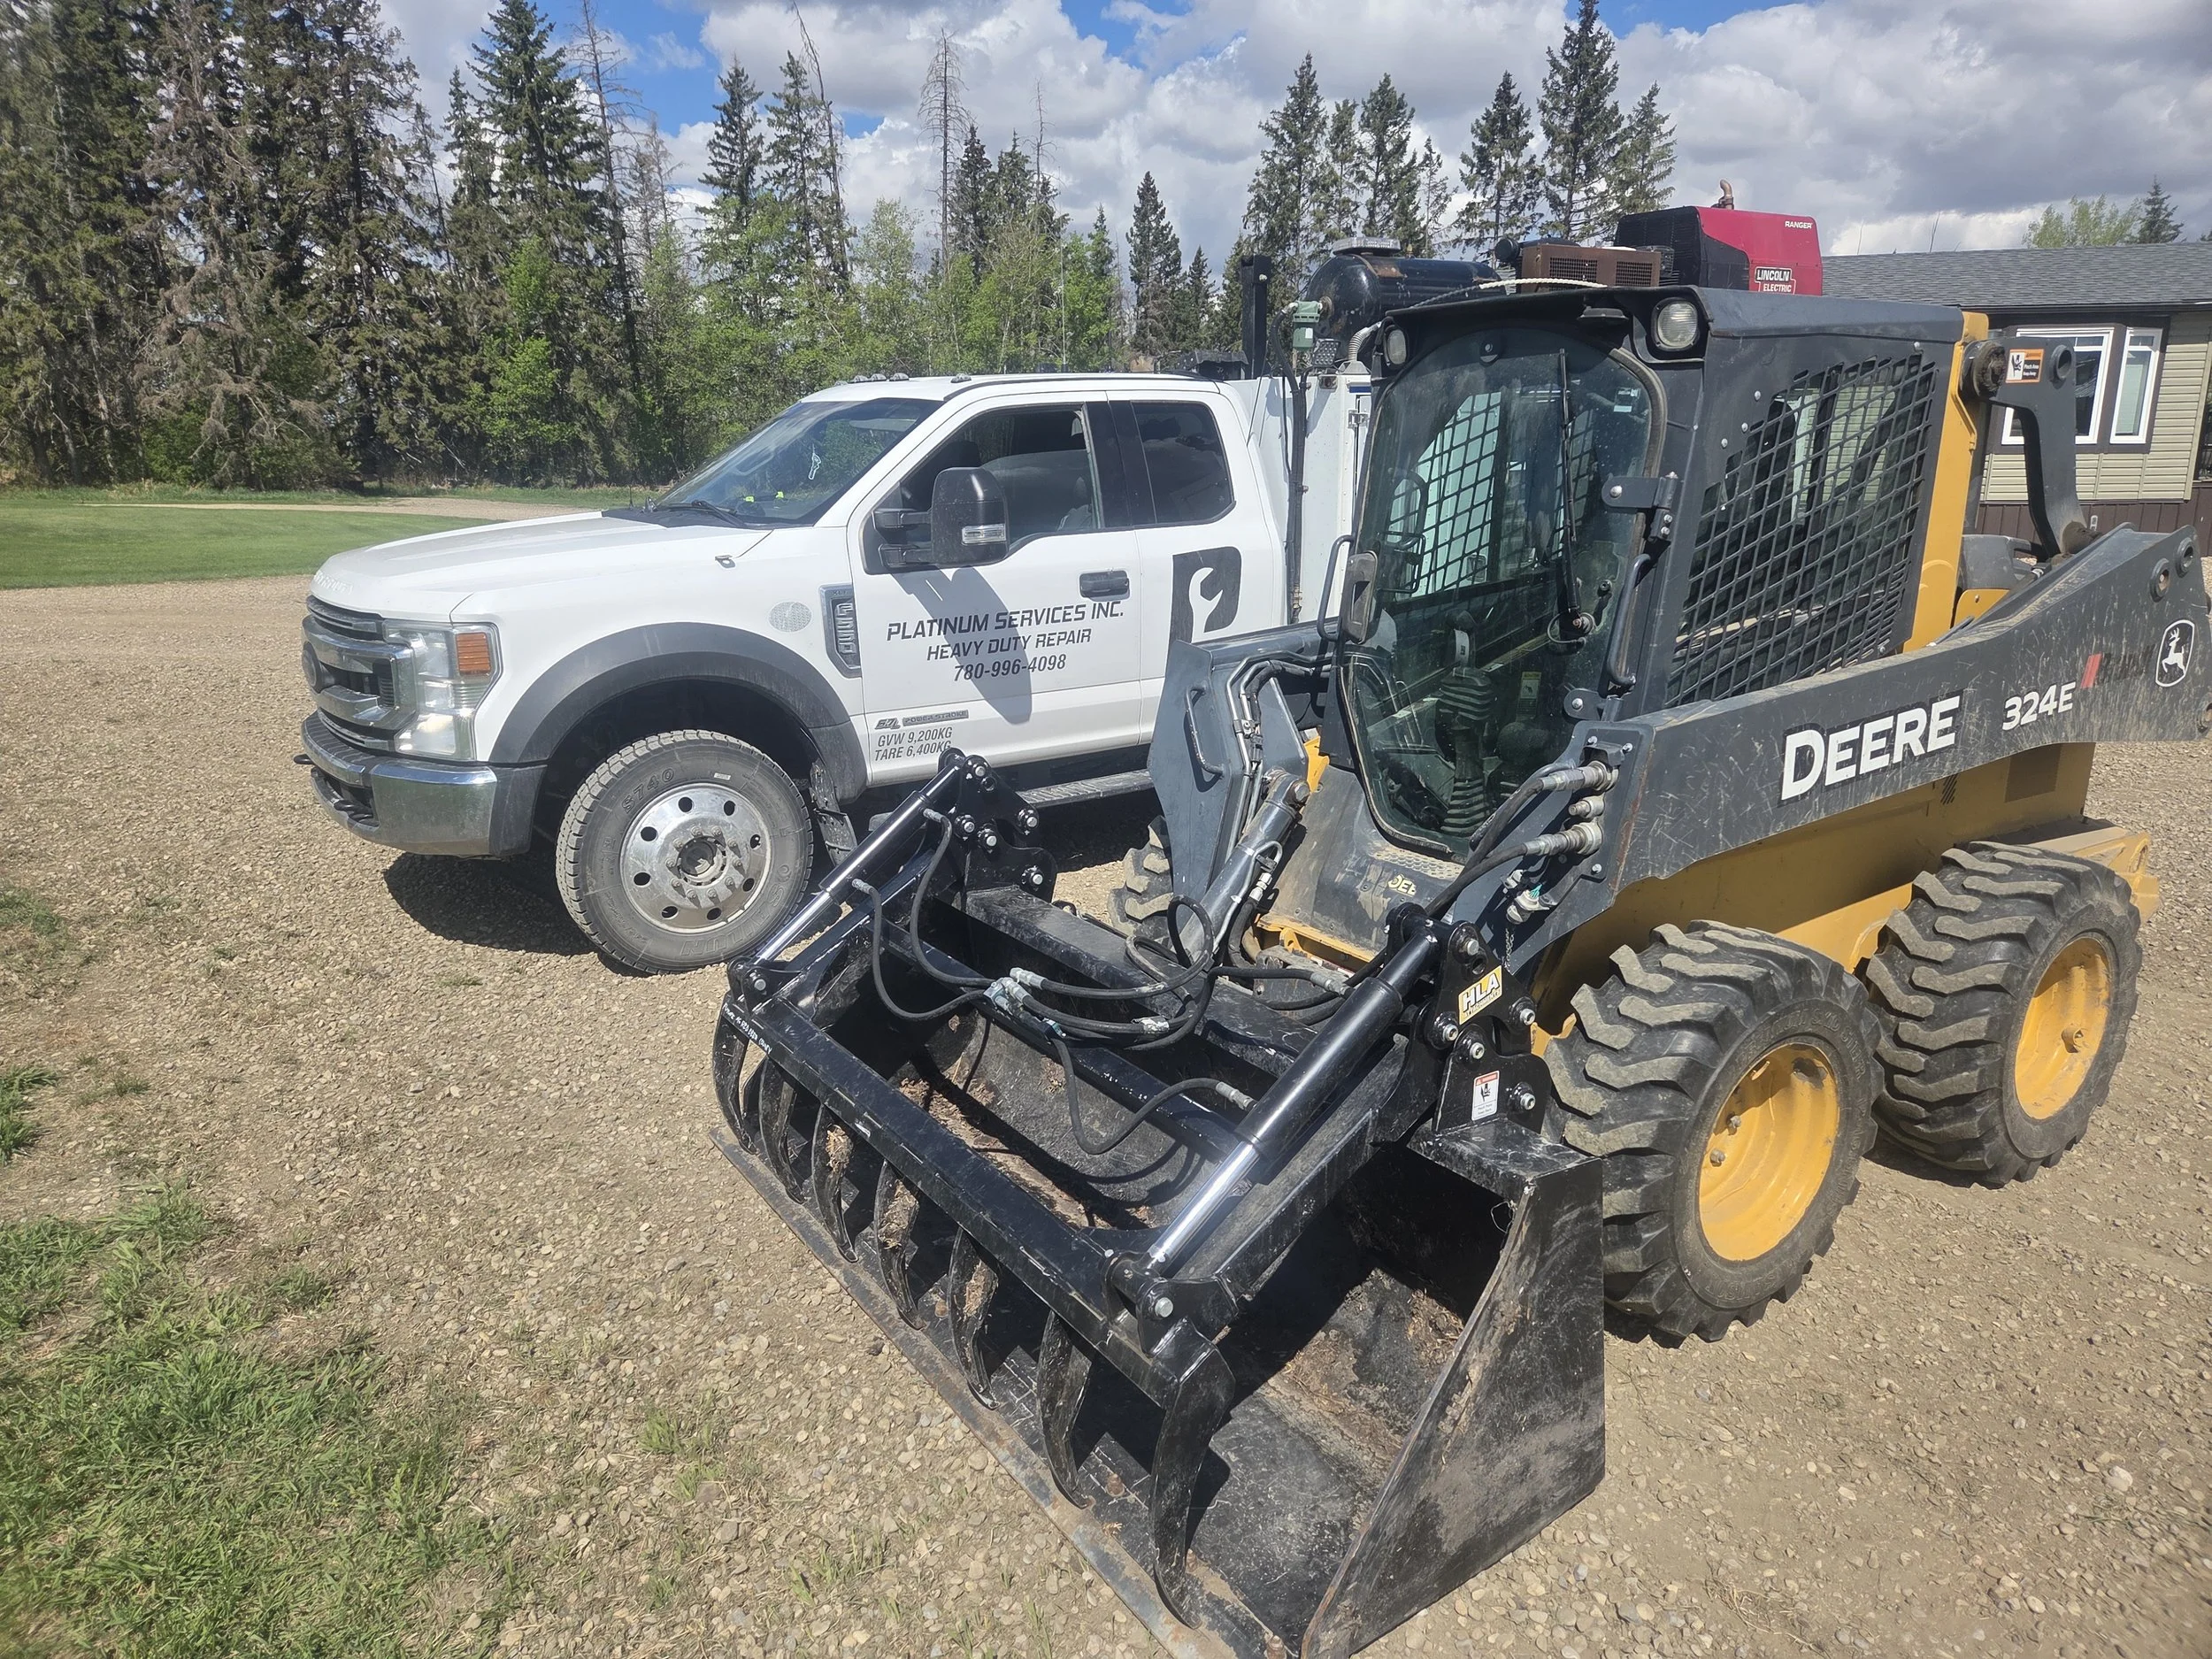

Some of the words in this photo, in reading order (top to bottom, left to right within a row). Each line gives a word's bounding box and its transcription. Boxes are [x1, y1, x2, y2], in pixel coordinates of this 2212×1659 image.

[1785, 220, 1813, 229] RANGER
[1756, 269, 1790, 281] LINCOLN
[1763, 283, 1792, 292] ELECTRIC
[887, 613, 989, 641] PLATINUM
[995, 604, 1087, 630] SERVICES
[1091, 601, 1124, 620] INC.
[927, 641, 984, 661] HEAVY
[987, 635, 1032, 654] DUTY
[1035, 628, 1092, 649] REPAIR
[954, 654, 1066, 681] 780-996-4098
[2001, 682, 2076, 731] 324E
[878, 733, 905, 747] GVW
[907, 726, 953, 744] 9,200KG
[1781, 695, 1961, 801] DEERE
[875, 747, 903, 761] TARE
[906, 741, 951, 757] 6,400KG
[1463, 972, 1500, 1012] HLA
